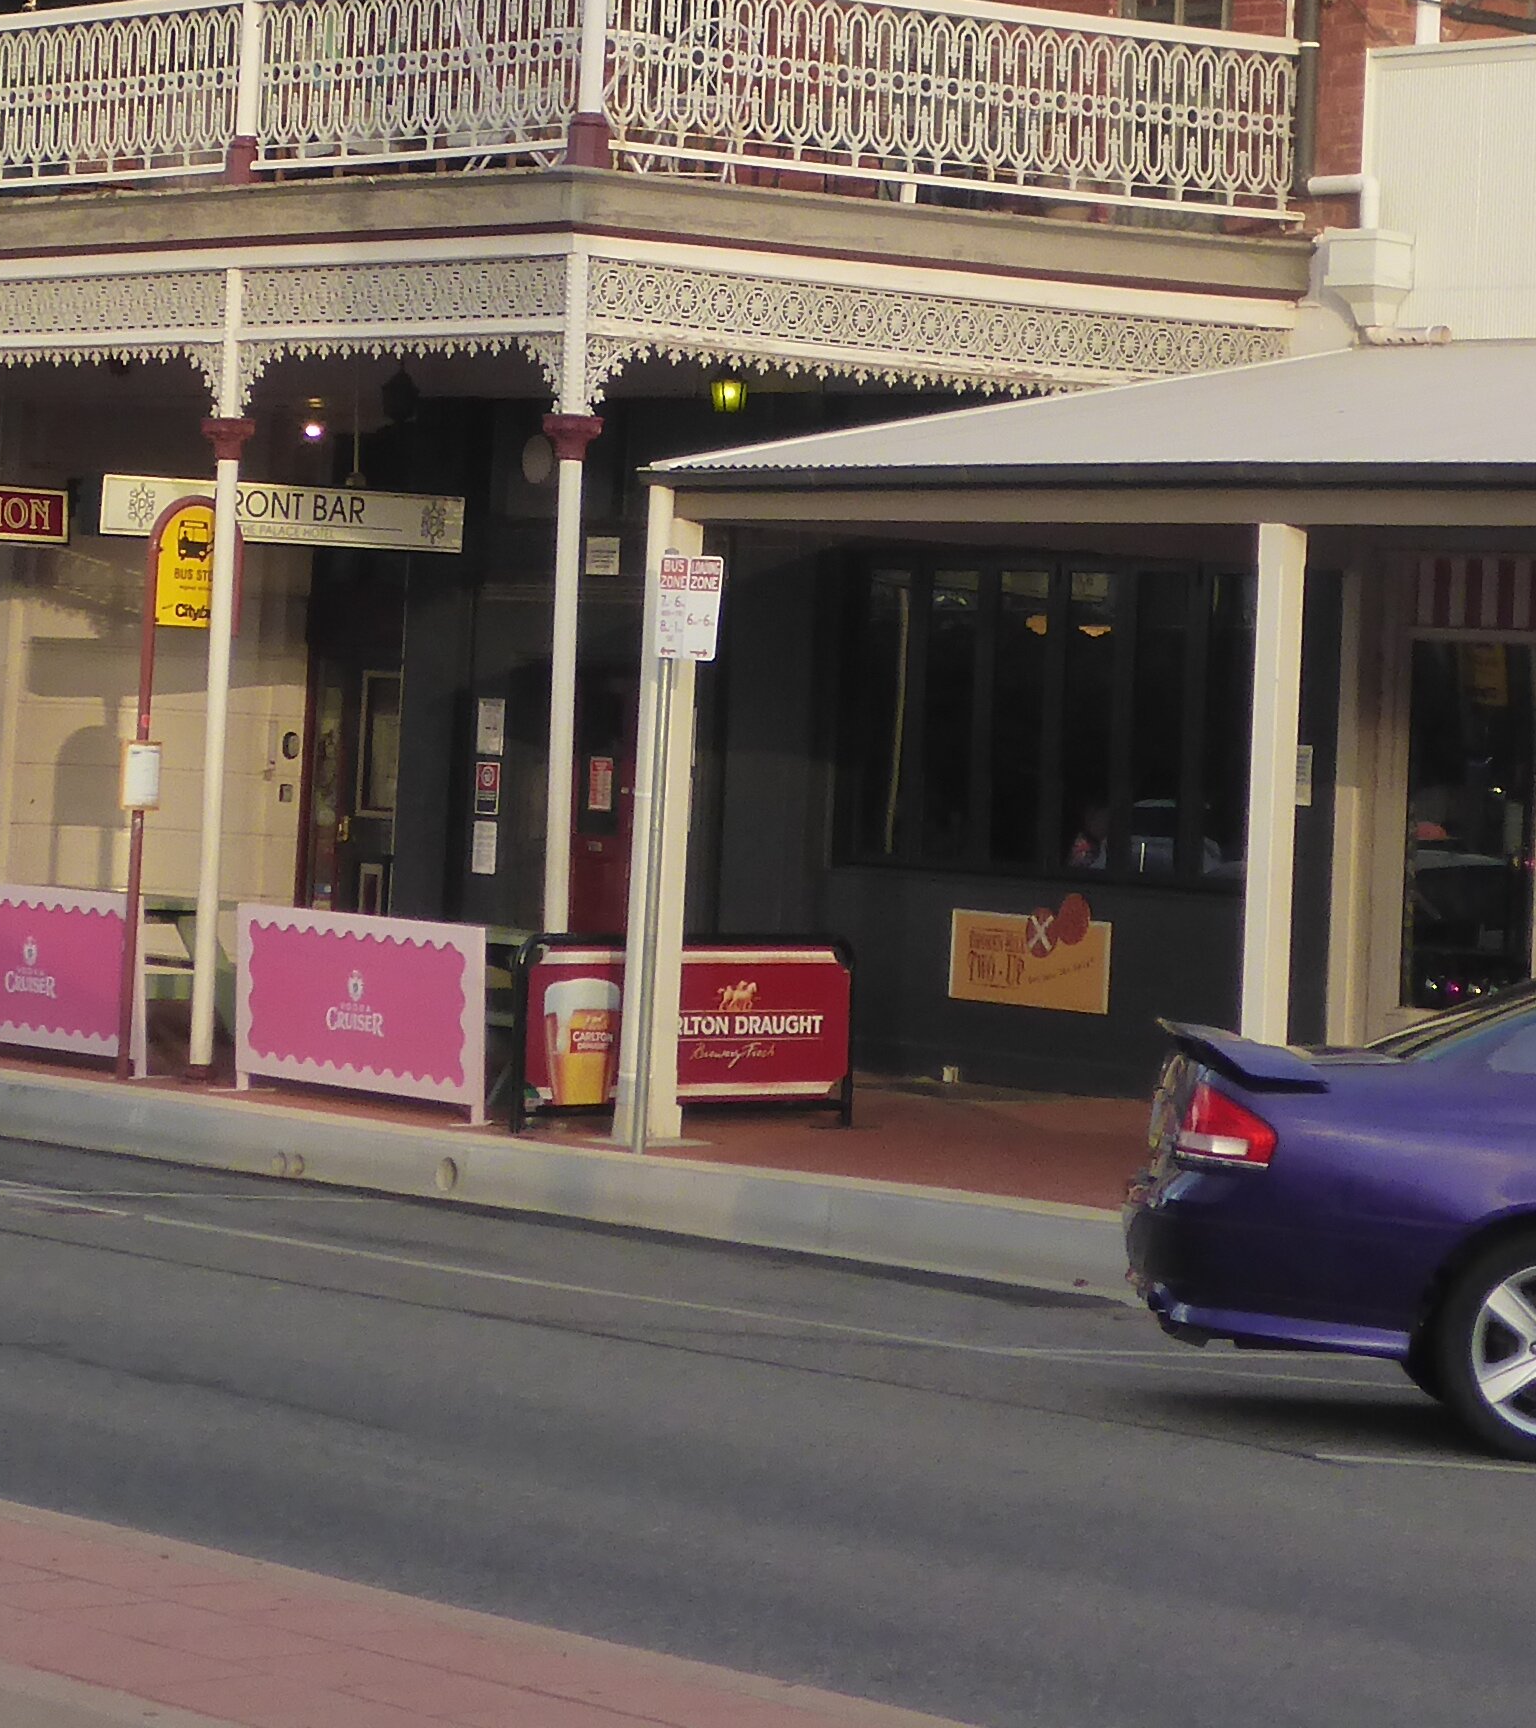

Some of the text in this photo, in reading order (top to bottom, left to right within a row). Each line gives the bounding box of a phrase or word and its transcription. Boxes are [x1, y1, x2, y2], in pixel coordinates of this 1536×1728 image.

[234, 489, 365, 524] RONT BAR
[663, 560, 685, 572] BUS
[174, 568, 213, 582] BUS STO
[660, 575, 687, 588] ZONE
[690, 576, 719, 589] ZONE
[326, 1006, 385, 1037] CRUISER
[677, 1015, 824, 1035] RLTON DRAUGHT
